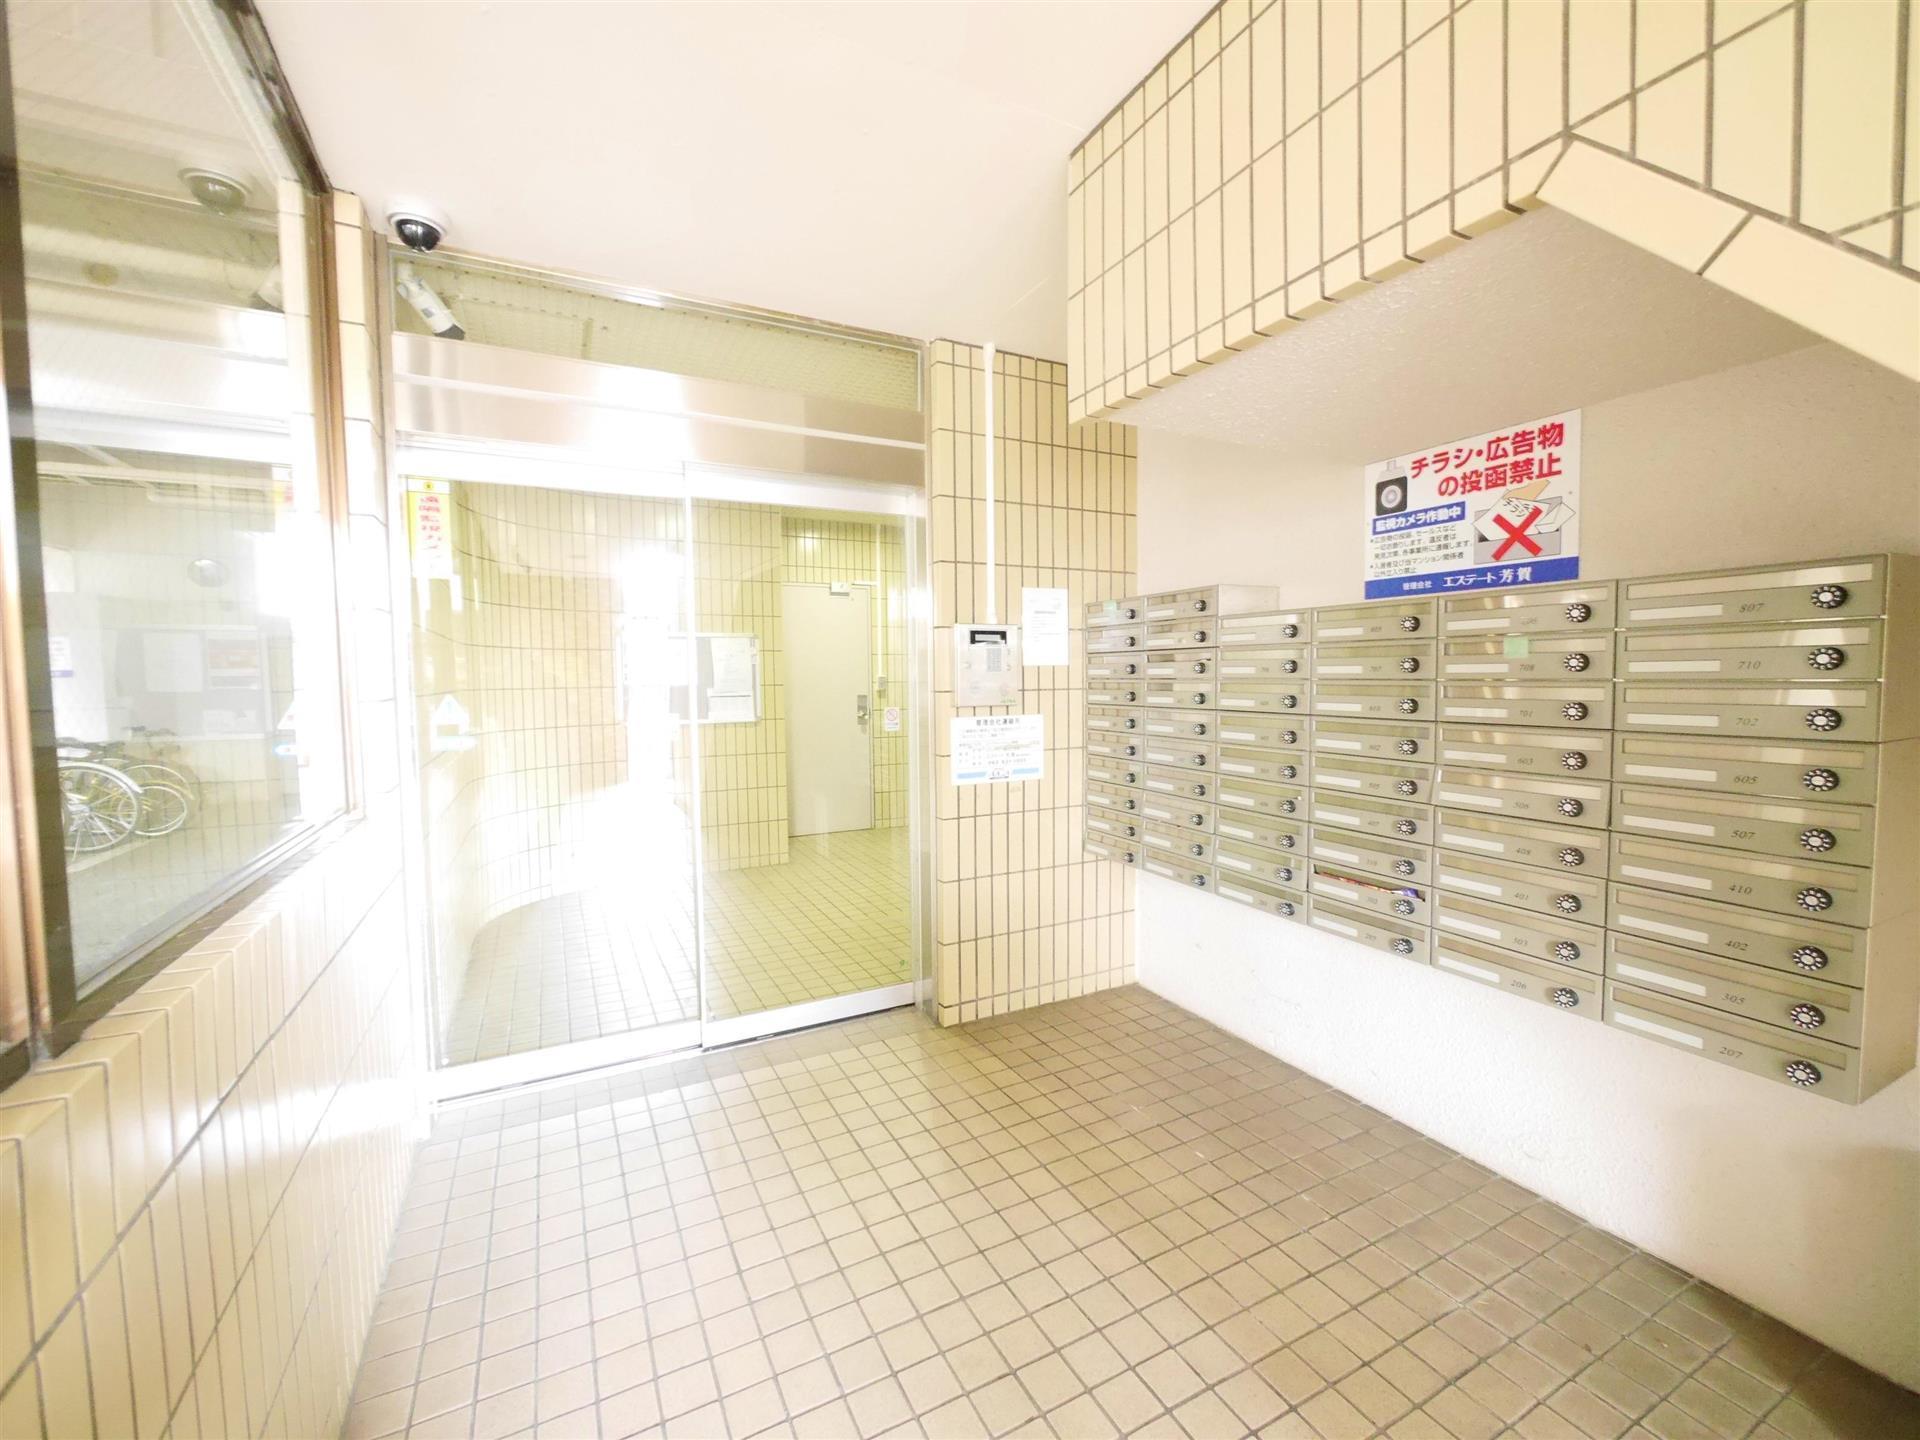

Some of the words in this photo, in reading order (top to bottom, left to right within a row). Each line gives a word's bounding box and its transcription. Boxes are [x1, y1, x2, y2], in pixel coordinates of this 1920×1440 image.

[1411, 422, 1564, 479] チラシ・広告物
[1438, 453, 1562, 497] の投函禁止
[1375, 505, 1462, 532] 監視カメラ作動中
[1739, 602, 1764, 613] 807
[1738, 660, 1761, 670] 710
[1736, 717, 1760, 727] 702
[1734, 775, 1758, 785] 605
[1731, 829, 1756, 840] 507
[1728, 884, 1753, 895] 410
[1514, 892, 1529, 901] 401
[1725, 940, 1749, 951] 402
[1721, 993, 1745, 1005] 305
[1718, 1046, 1744, 1059] 207
